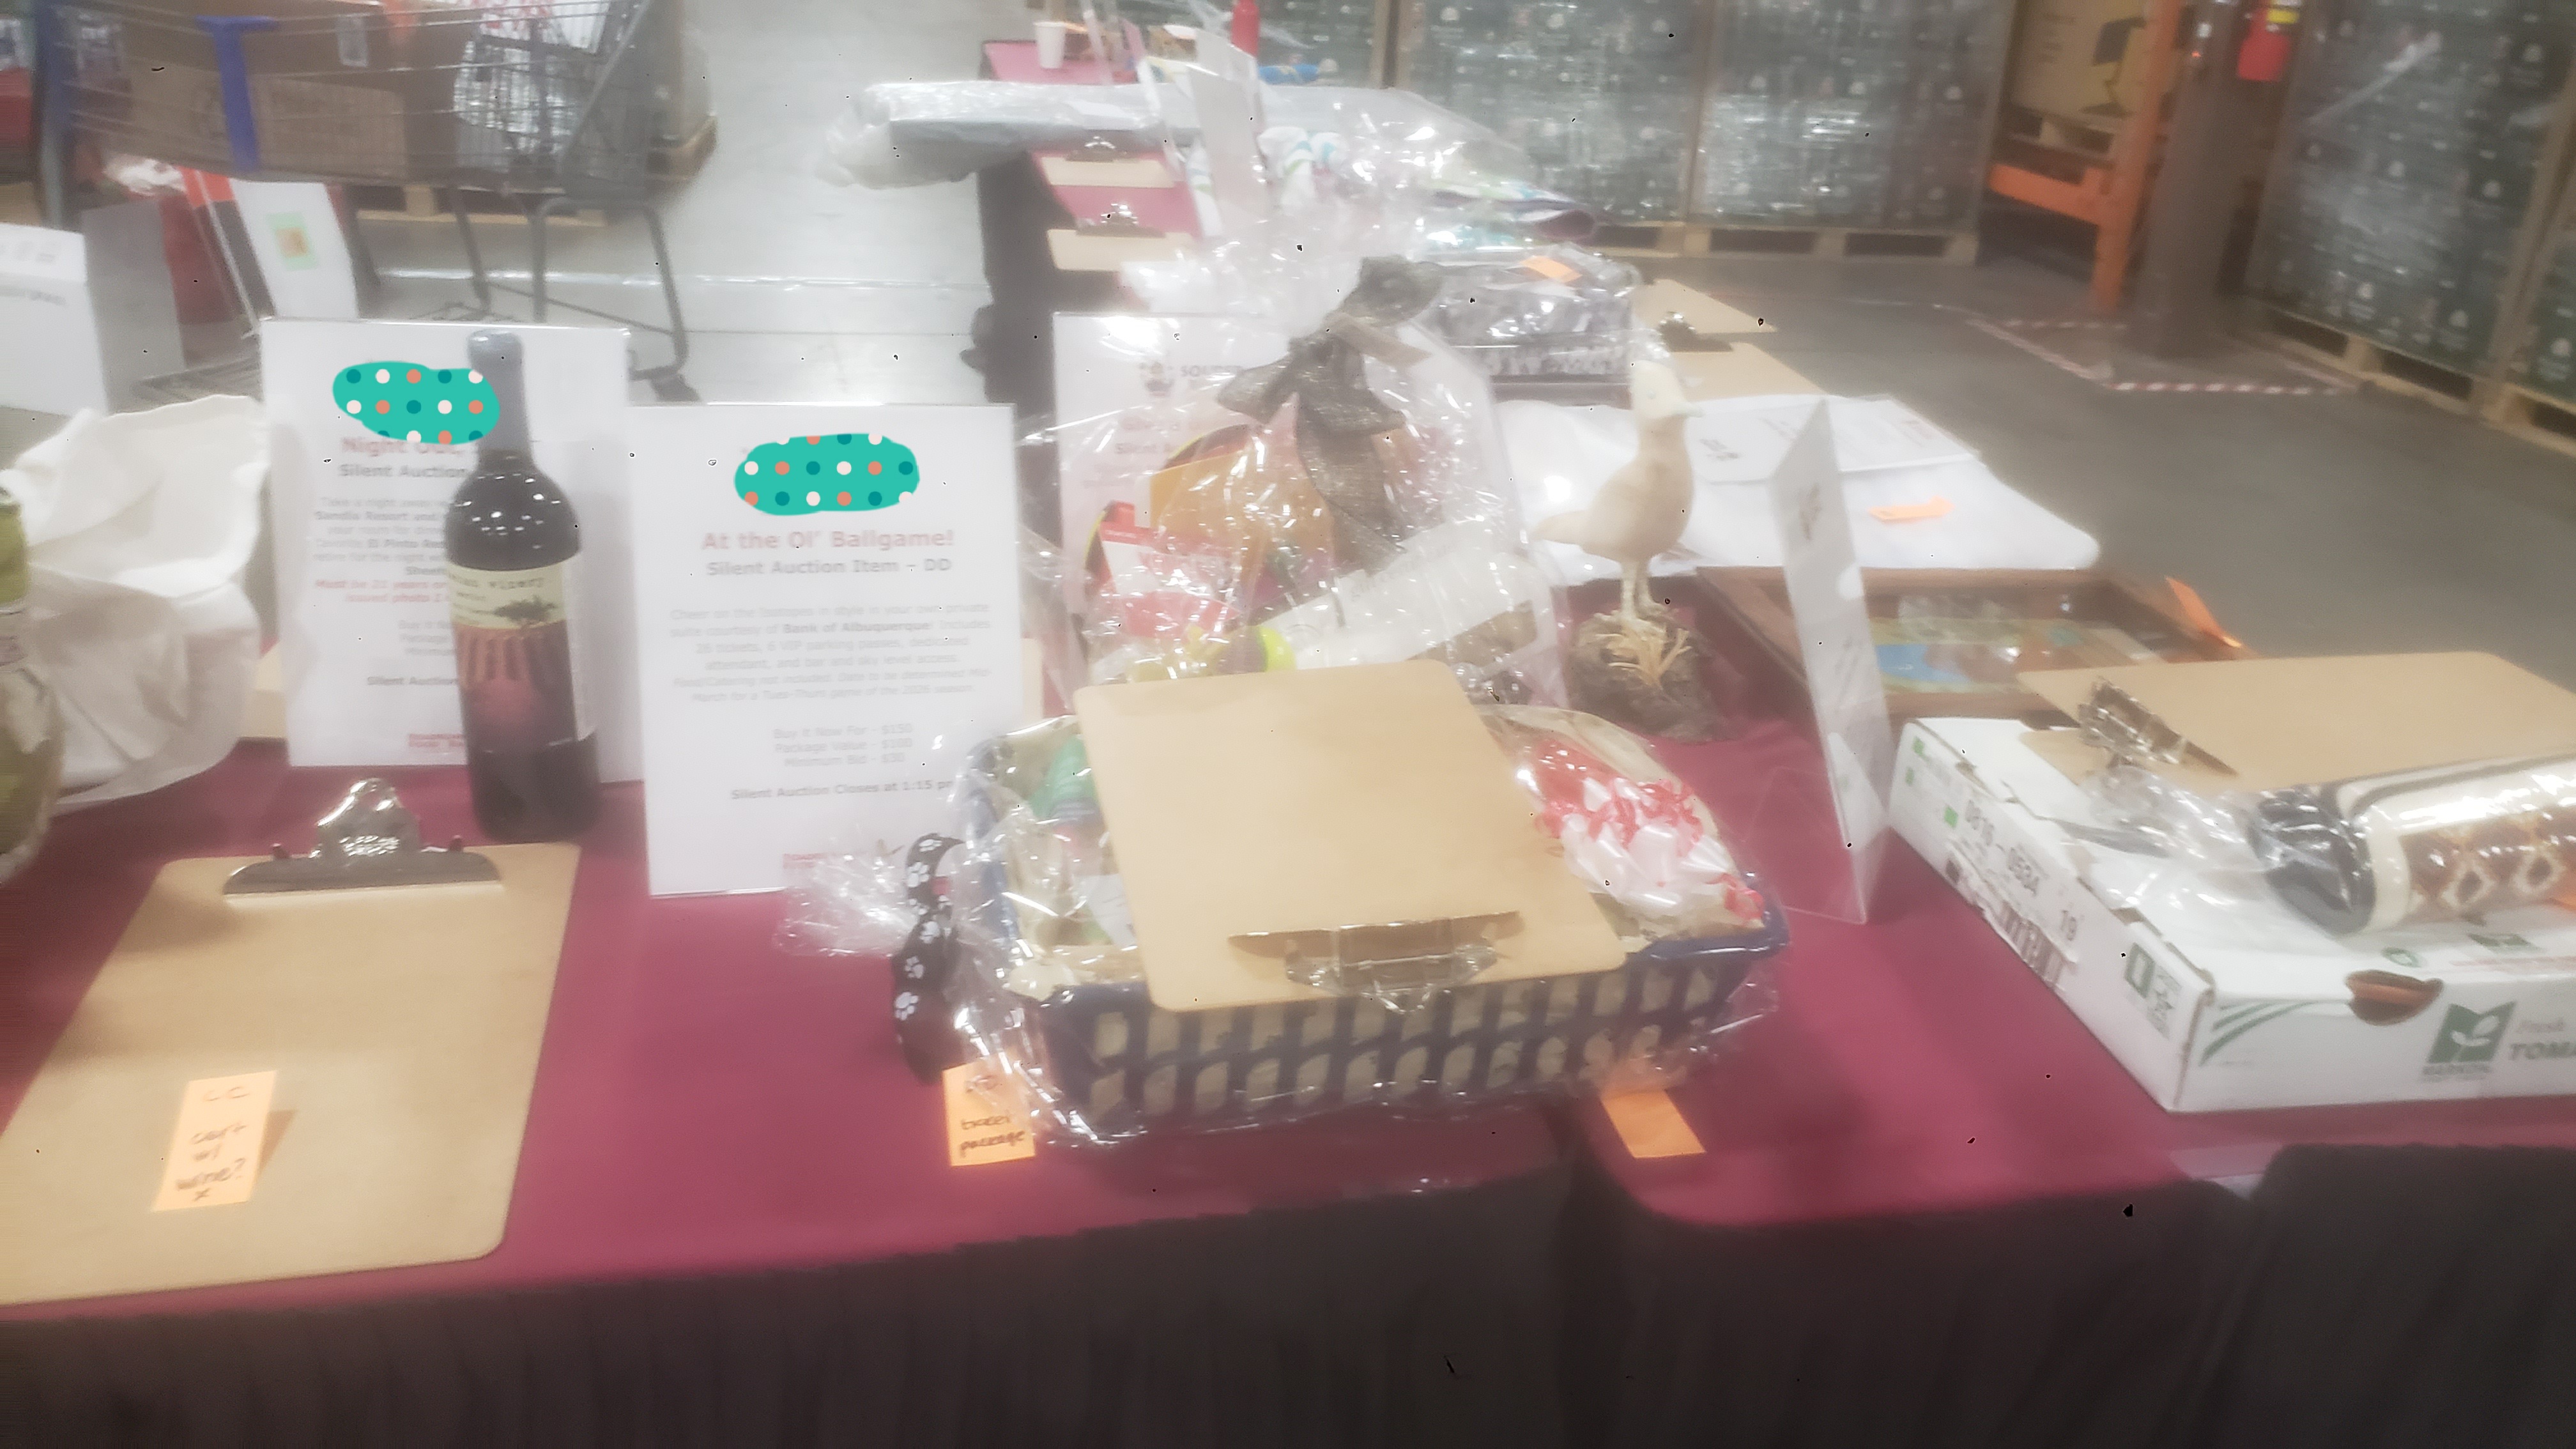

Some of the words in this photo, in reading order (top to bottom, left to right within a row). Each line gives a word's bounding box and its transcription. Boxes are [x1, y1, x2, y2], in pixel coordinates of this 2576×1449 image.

[339, 463, 392, 477] Silent
[399, 464, 466, 478] Auction
[702, 531, 730, 550] At
[738, 530, 780, 549] the
[831, 529, 955, 552] Ballgame!
[707, 560, 763, 576] Silent
[770, 558, 846, 574] Auction
[852, 558, 900, 573] Item
[924, 557, 952, 572] DD
[782, 623, 818, 634] Bank
[822, 622, 838, 633] of
[772, 728, 798, 740] Buy
[815, 726, 843, 737] Now
[845, 724, 868, 735] For
[774, 742, 828, 755] Package
[831, 740, 868, 751] Value
[730, 788, 772, 801] Silent
[776, 786, 830, 799] Auction
[833, 783, 880, 795] Closes
[884, 782, 898, 792] at
[902, 779, 933, 791] 1:15
[2508, 1040, 2576, 1061] TOM
